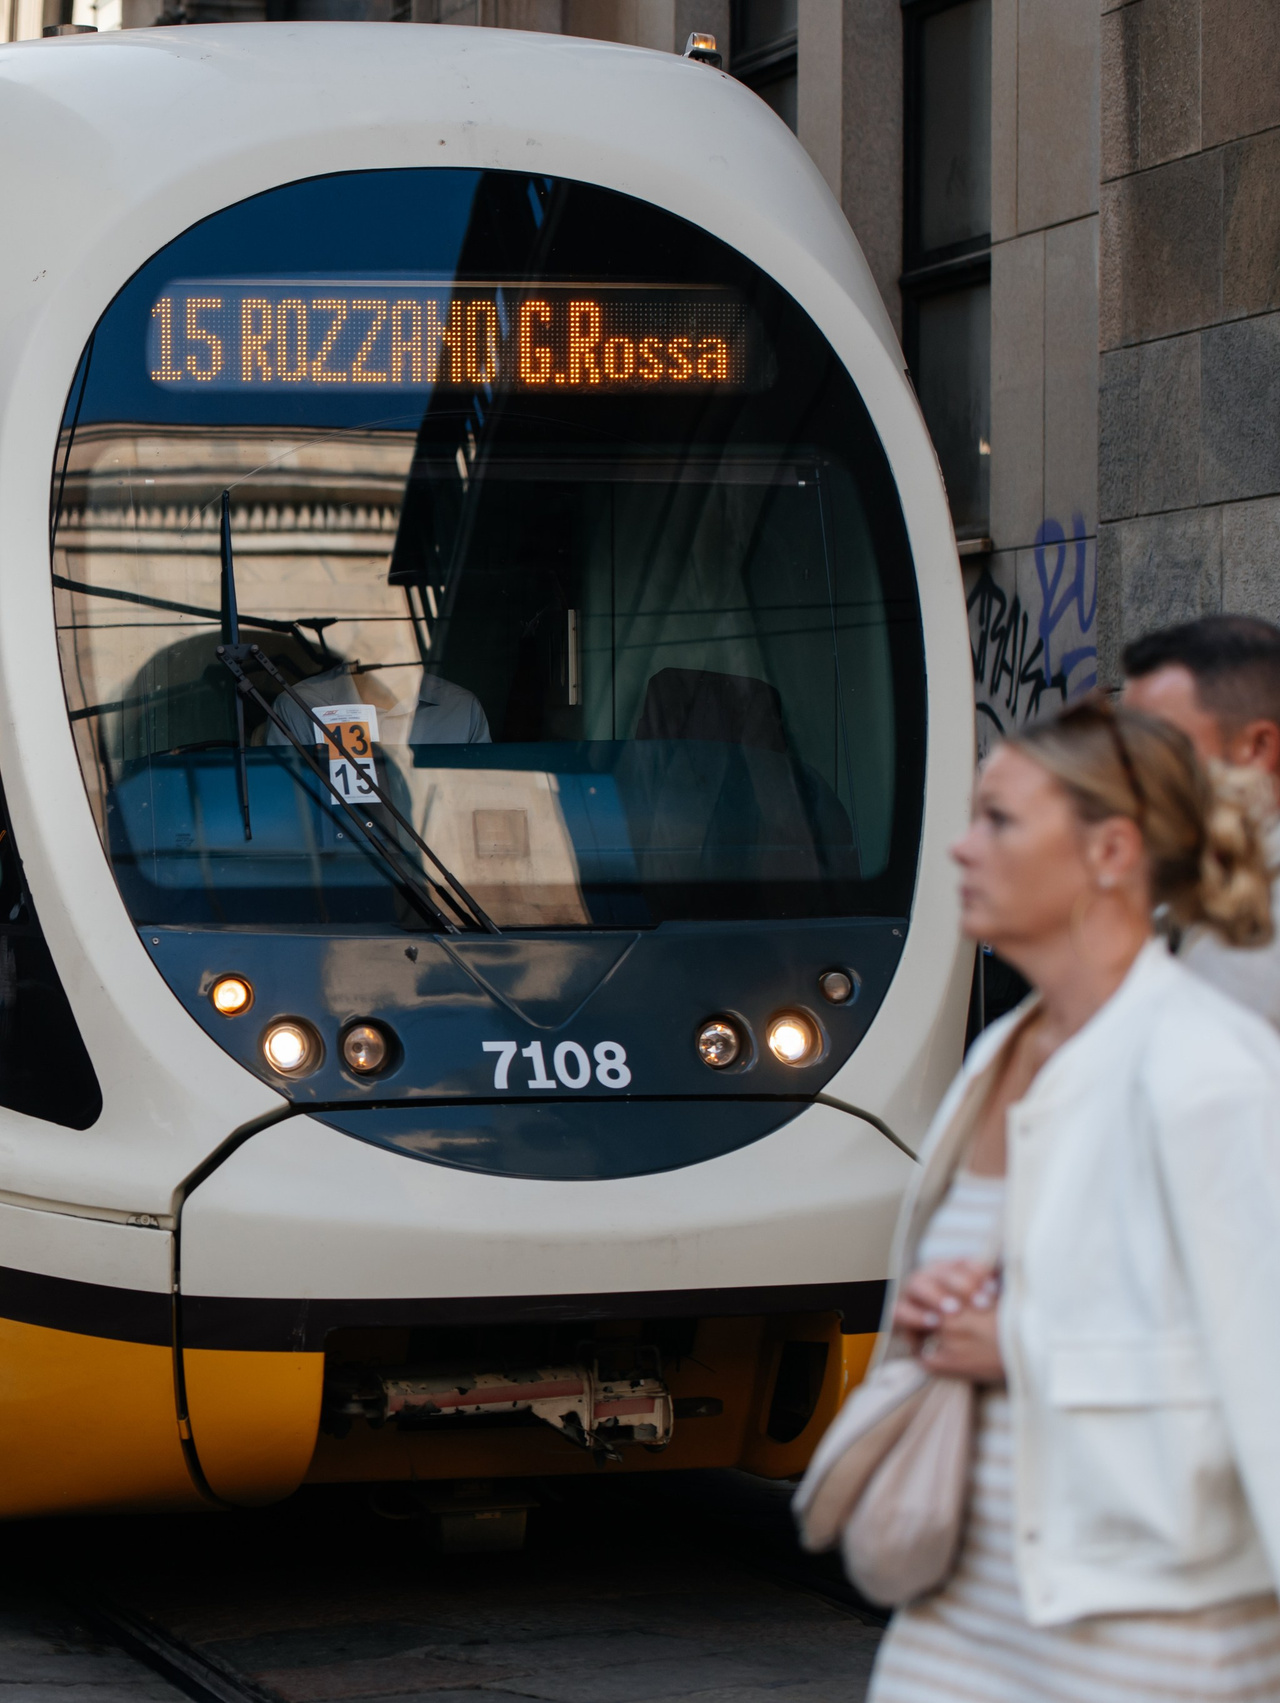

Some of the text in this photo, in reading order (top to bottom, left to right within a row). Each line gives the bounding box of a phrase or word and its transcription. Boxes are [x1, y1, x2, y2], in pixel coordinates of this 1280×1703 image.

[150, 297, 728, 384] 15 ROZZANO G.Rossa
[330, 724, 368, 757] 13
[334, 763, 373, 796] 15
[481, 1040, 632, 1089] 7108
